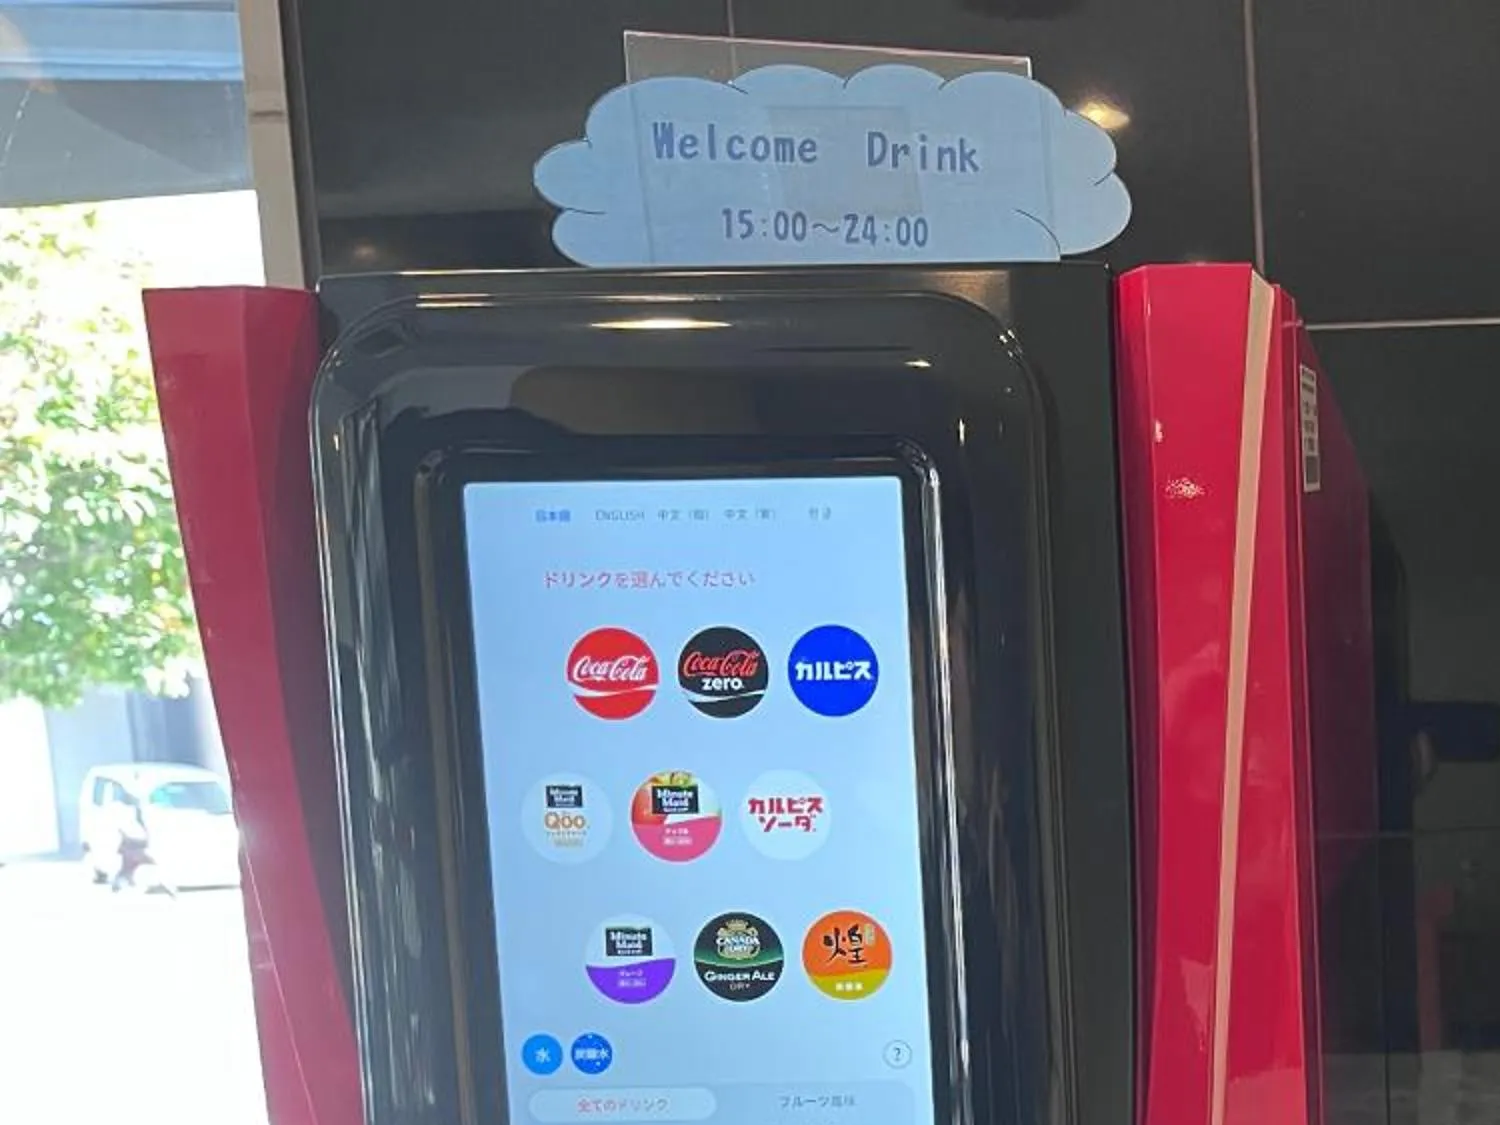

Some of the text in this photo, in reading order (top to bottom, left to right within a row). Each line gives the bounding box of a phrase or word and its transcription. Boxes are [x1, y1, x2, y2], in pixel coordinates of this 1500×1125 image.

[652, 122, 980, 173] Welcome Drink
[544, 567, 757, 590] ドリンクを選んでください
[794, 660, 874, 682] カルピス
[702, 676, 745, 692] zero
[748, 796, 824, 814] カルピス
[758, 815, 817, 832] ソーダ
[751, 969, 775, 981] ALE
